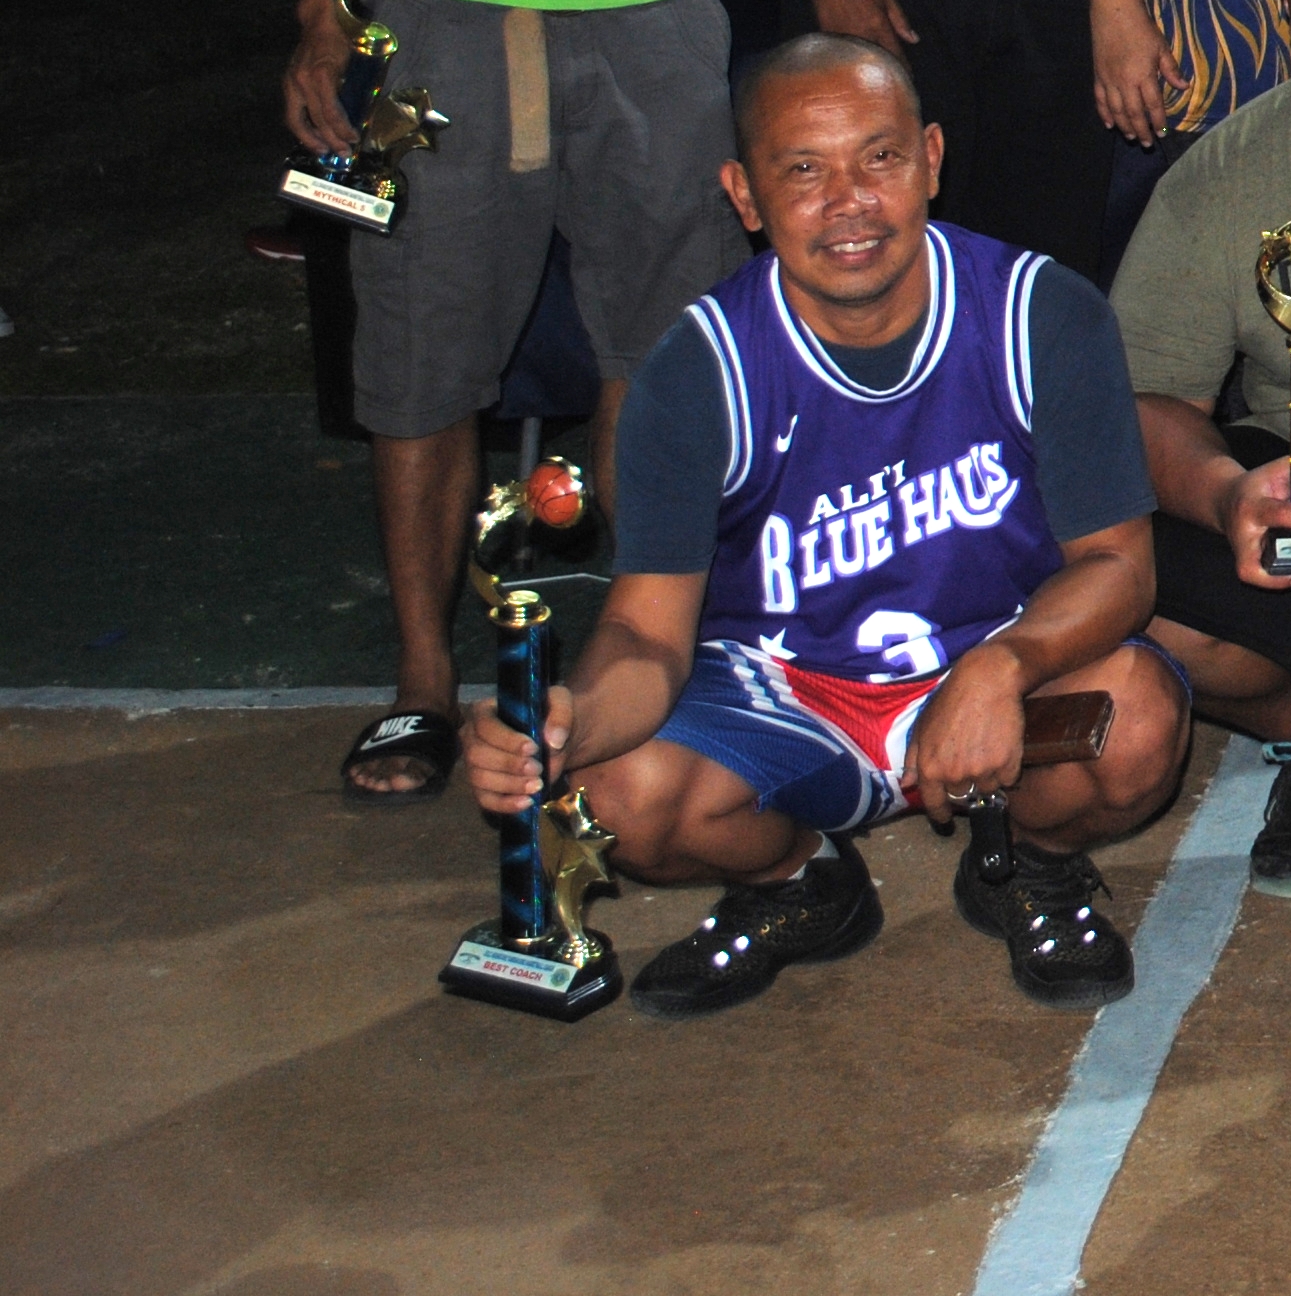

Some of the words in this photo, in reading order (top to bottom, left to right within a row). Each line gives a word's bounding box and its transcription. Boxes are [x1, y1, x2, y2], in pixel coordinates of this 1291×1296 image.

[313, 190, 358, 210] MYTHICAL
[807, 459, 908, 525] ALI'I
[760, 503, 897, 614] BLUE
[856, 610, 948, 685] 3
[373, 715, 424, 739] NIKE
[482, 960, 510, 973] BEST
[510, 967, 543, 981] COACH
